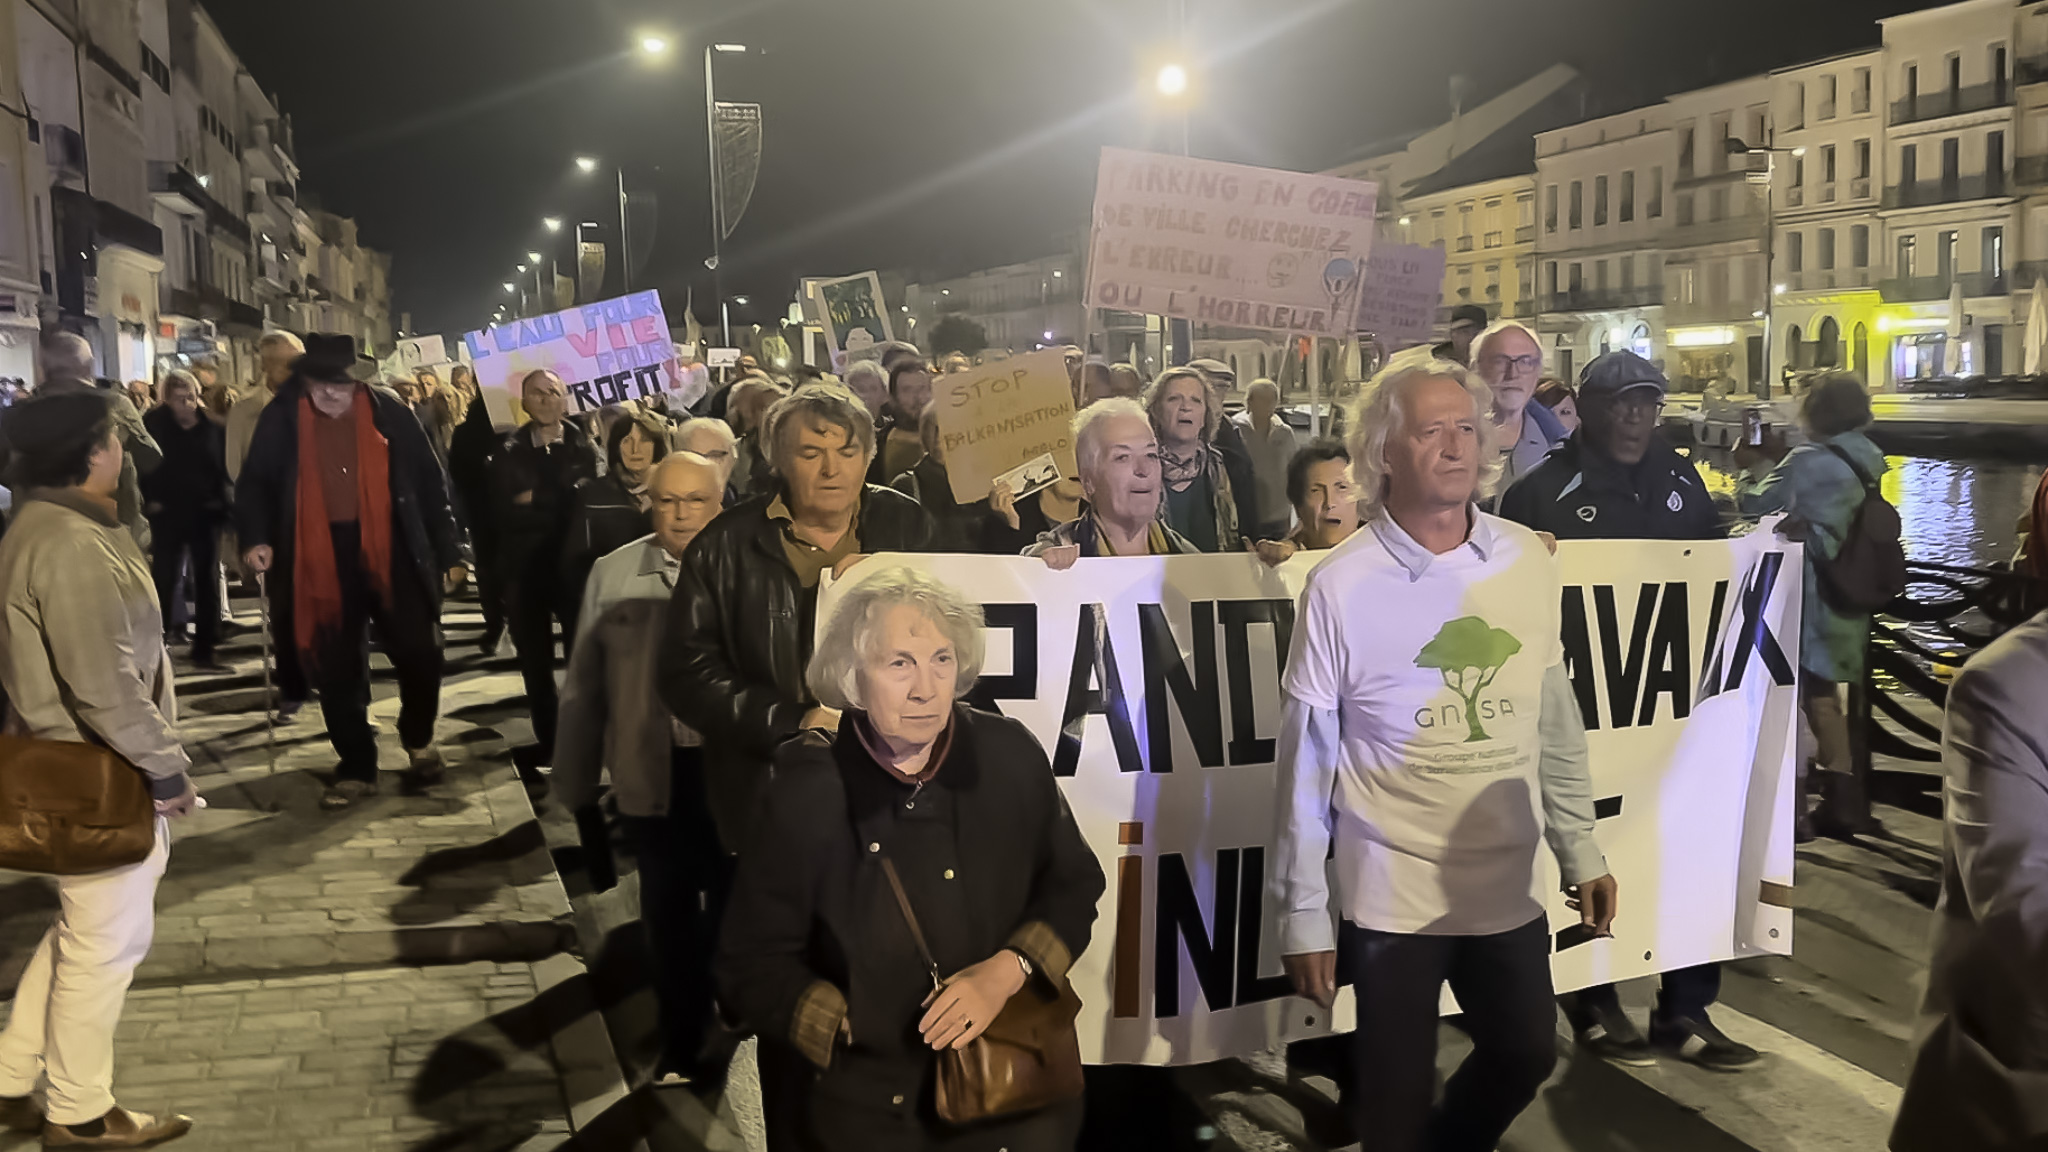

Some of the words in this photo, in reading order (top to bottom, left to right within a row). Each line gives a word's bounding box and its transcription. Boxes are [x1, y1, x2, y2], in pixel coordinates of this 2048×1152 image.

[1253, 179, 1297, 208] EN
[1225, 215, 1353, 254] CHERCHEZ
[580, 290, 662, 332] POUR
[1099, 278, 1143, 308] OU
[1167, 284, 1325, 332] L'HORREUR
[566, 315, 662, 358] VIE
[950, 369, 1028, 408] STOP
[943, 403, 1070, 451] BALKANISATION
